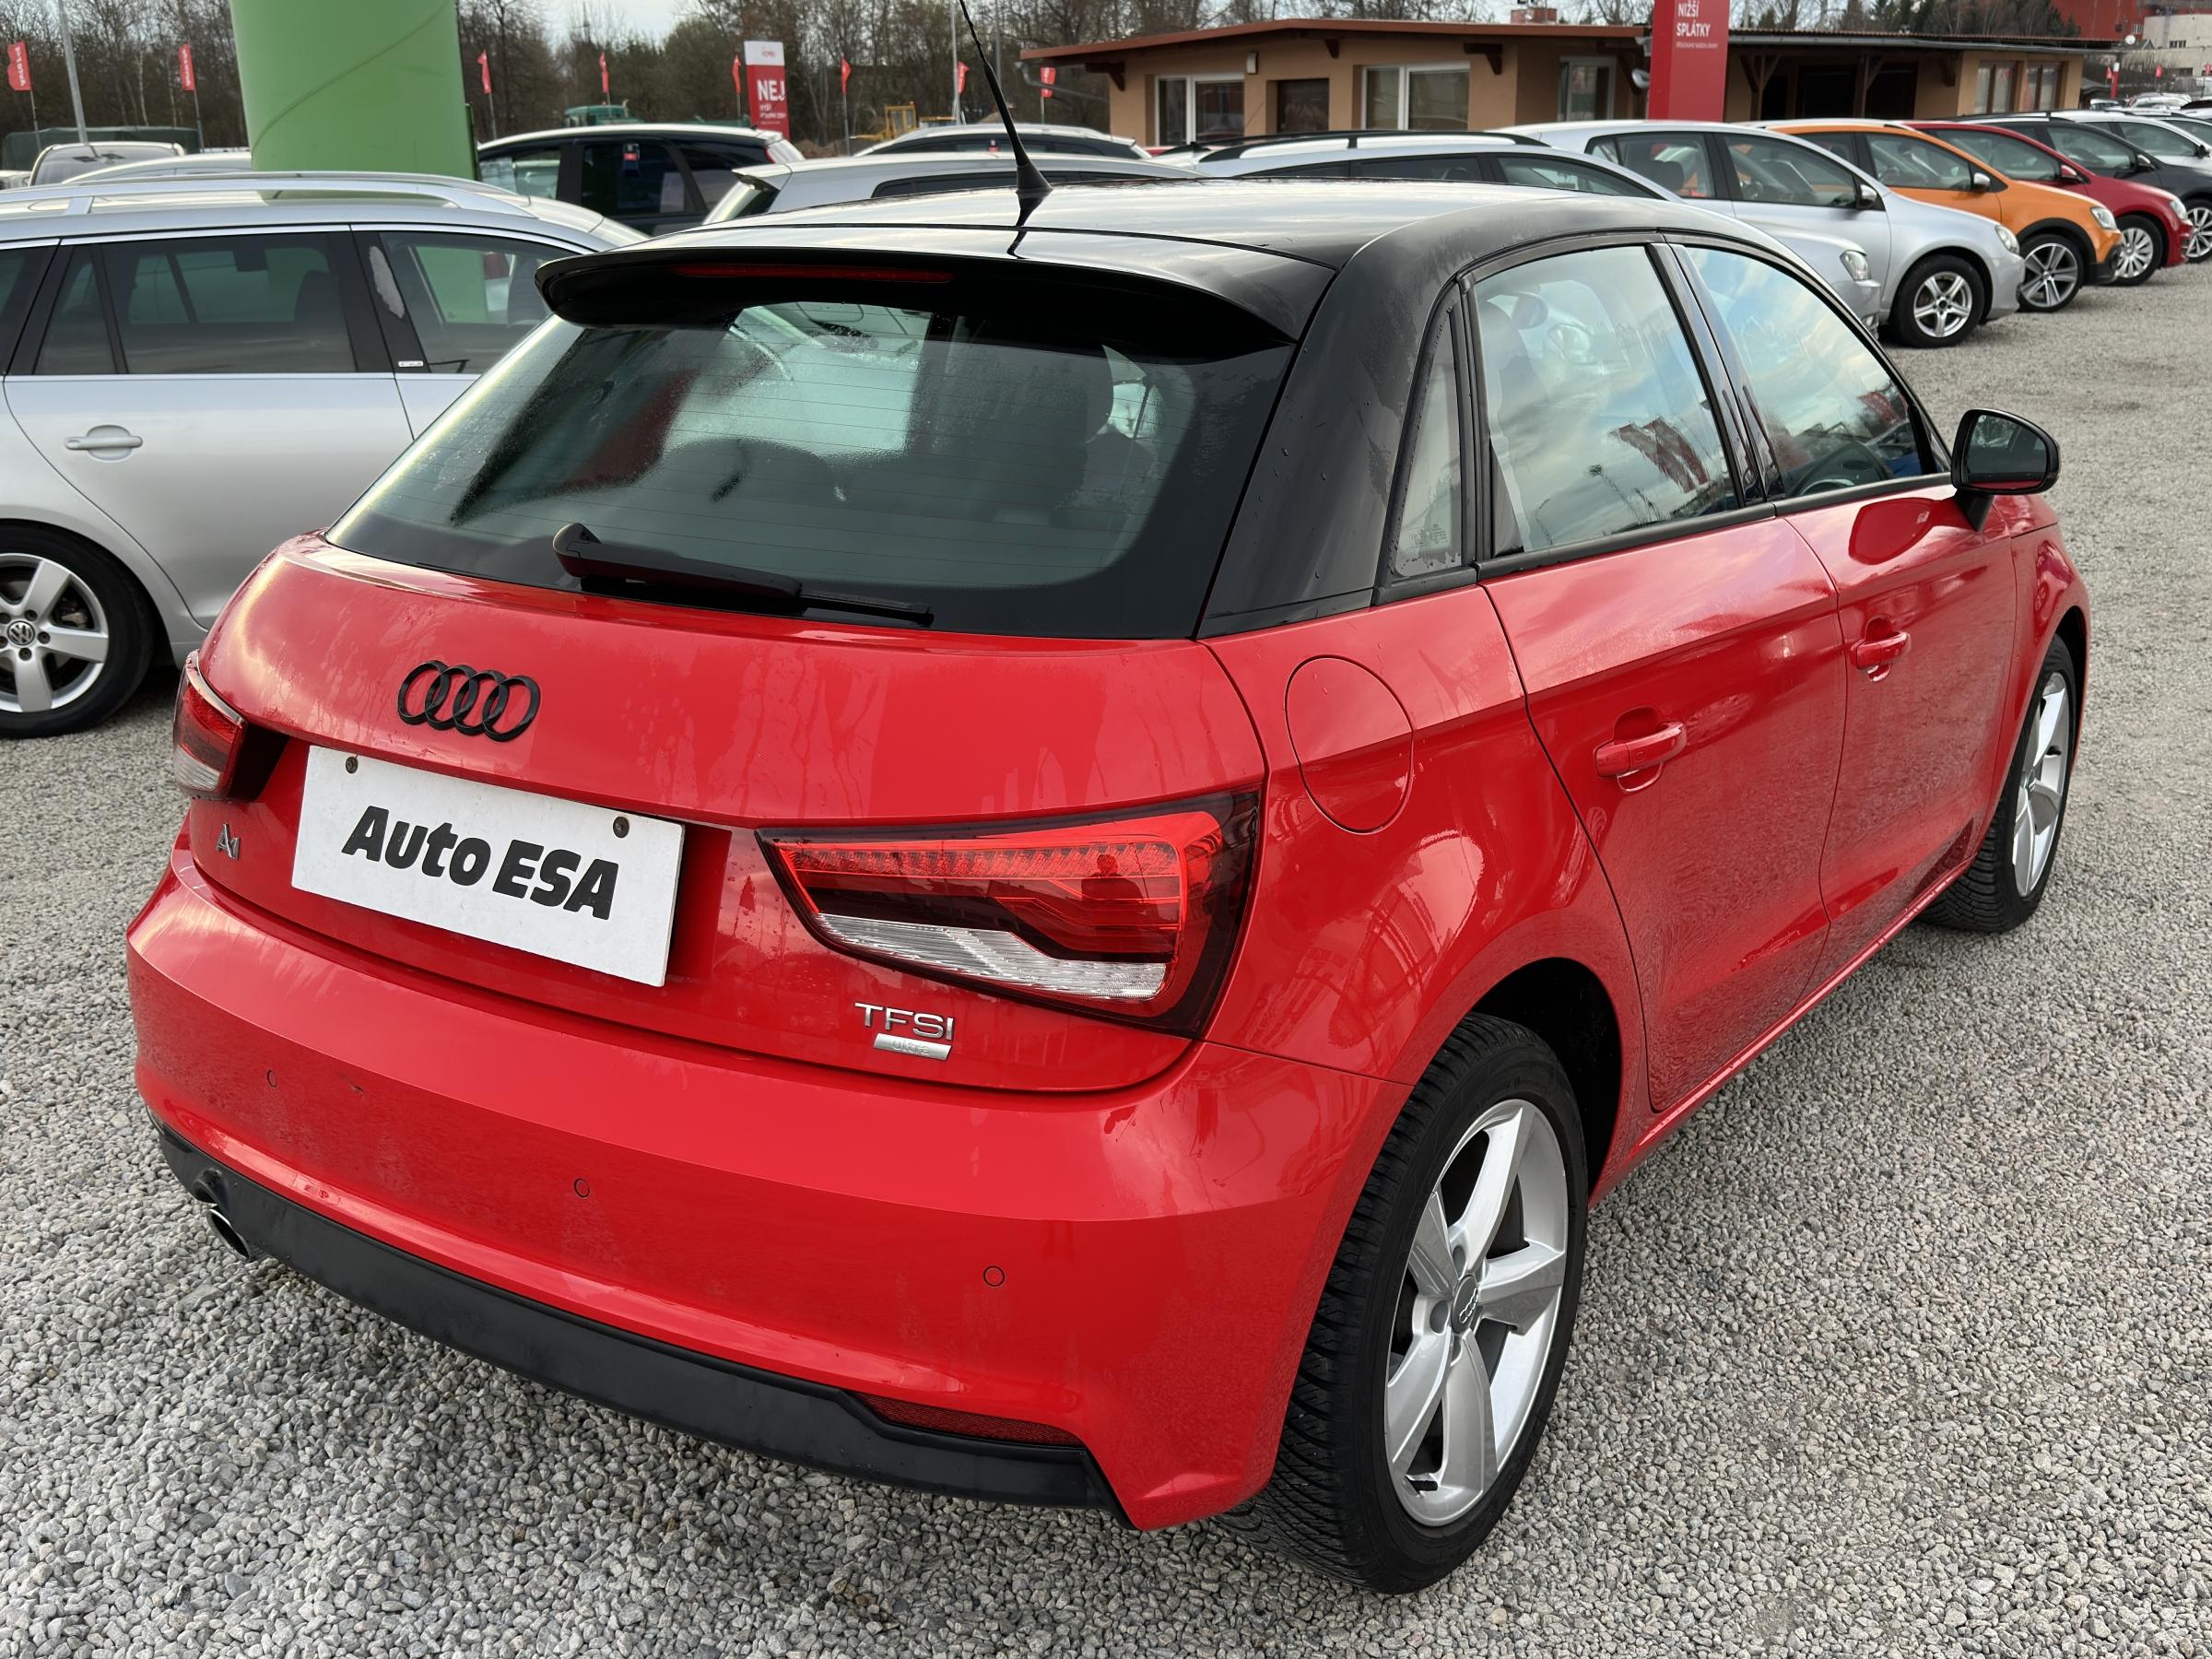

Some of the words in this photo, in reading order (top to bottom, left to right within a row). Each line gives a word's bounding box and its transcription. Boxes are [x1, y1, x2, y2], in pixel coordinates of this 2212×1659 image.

[1677, 0, 1700, 18] NIŽŠÍ
[1676, 18, 1711, 37] SPLÁTKY
[757, 80, 785, 101] NEJ
[341, 805, 492, 888] Auto
[492, 839, 620, 921] ESA
[854, 1002, 955, 1041] TFSI
